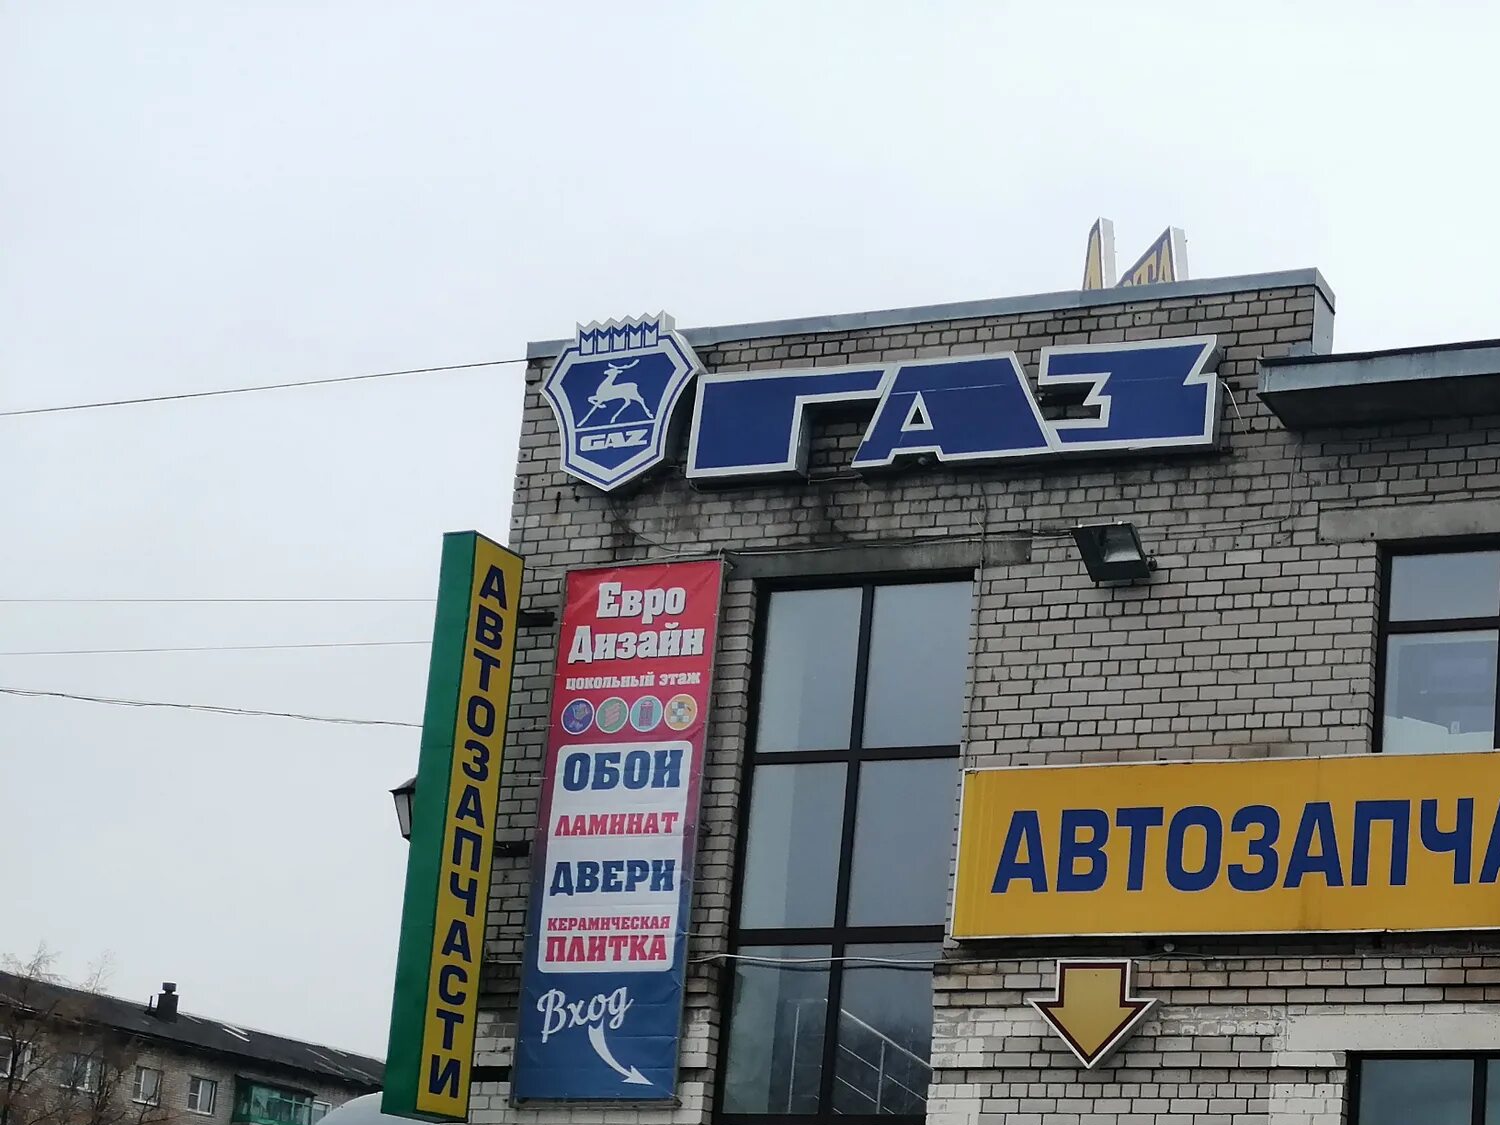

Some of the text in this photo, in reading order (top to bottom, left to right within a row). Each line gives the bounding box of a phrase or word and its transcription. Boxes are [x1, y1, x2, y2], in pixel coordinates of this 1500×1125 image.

[687, 334, 1219, 479] ГАЗ
[580, 429, 648, 452] GAZ
[597, 582, 687, 624] Евро
[568, 622, 705, 665] Дизайн
[565, 671, 701, 690] цокольный этаж
[563, 749, 682, 791] ОБОИ
[428, 564, 508, 1099] АВТОЗАПЧАСТИ
[555, 810, 679, 837] ЛАМИНАТ
[550, 859, 675, 896] ДВЕРИ
[548, 916, 671, 931] КЕРАМИЧЕСКАЯ
[546, 935, 667, 962] ПЛИТКА
[537, 986, 634, 1042] Вход
